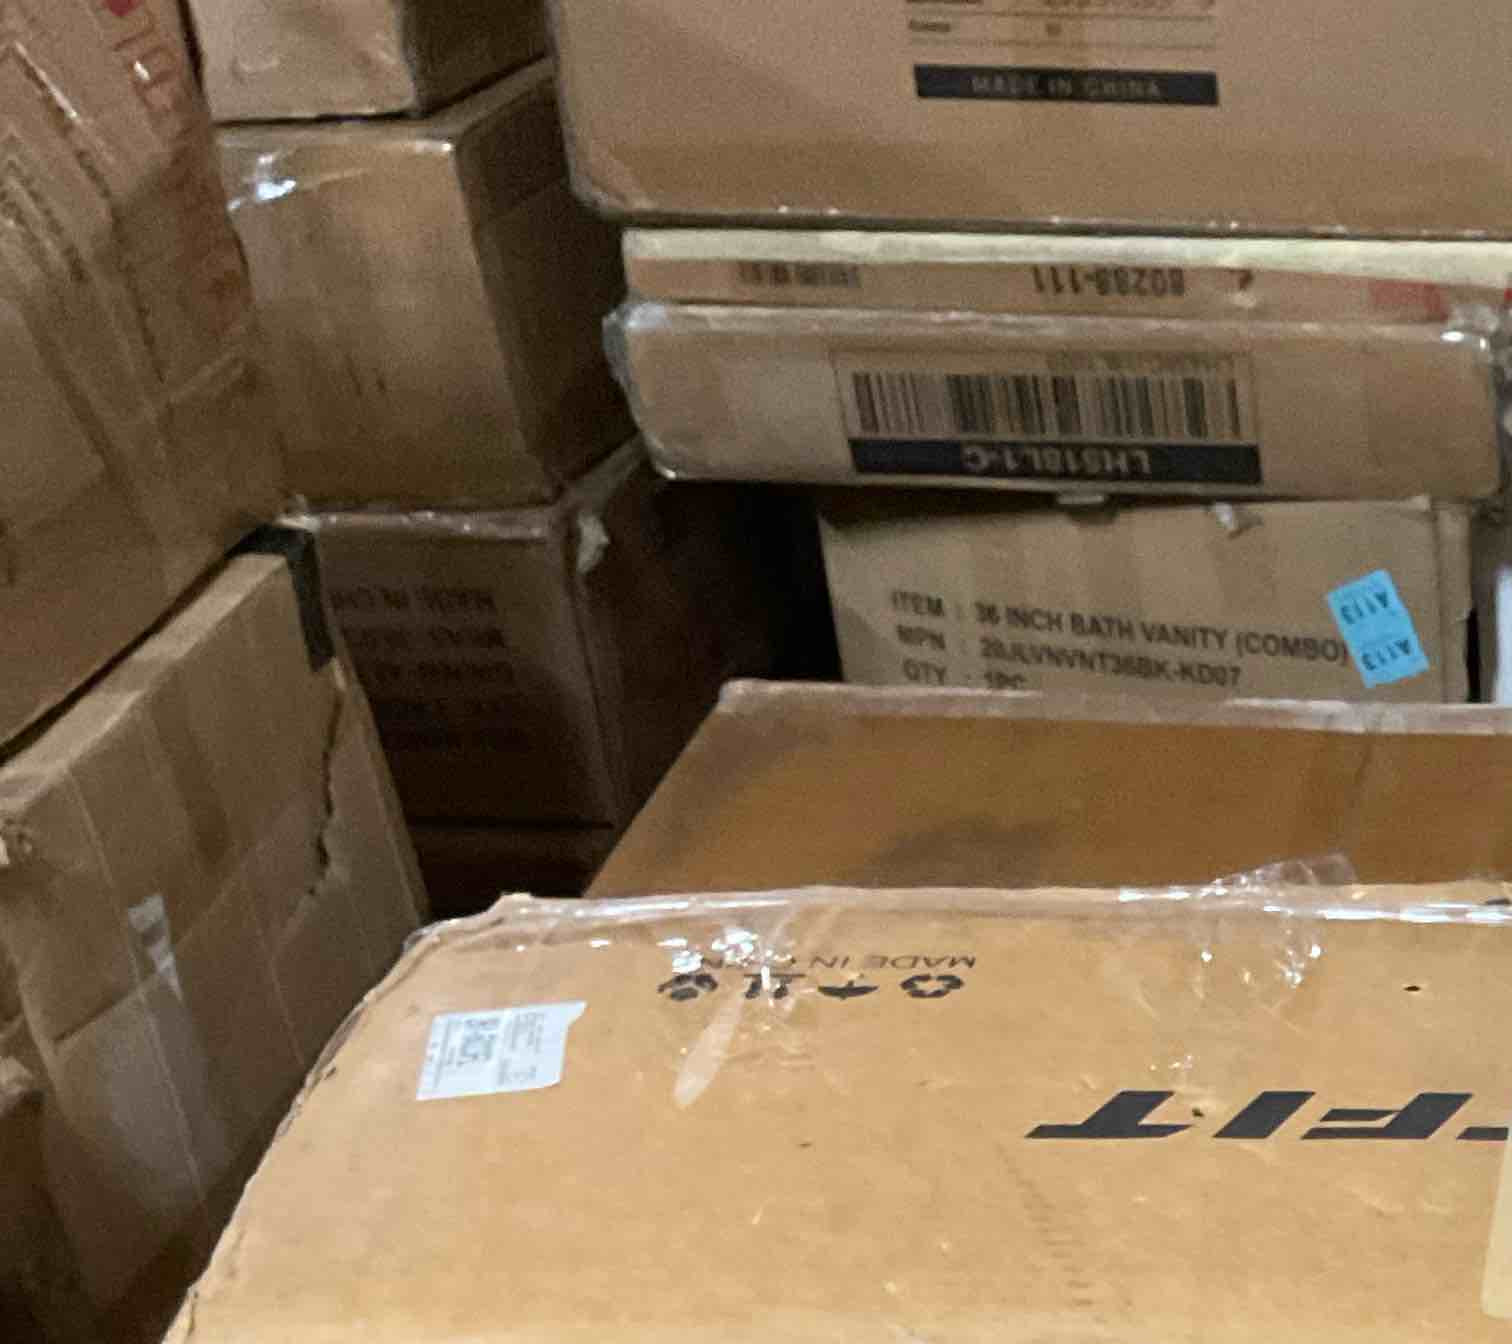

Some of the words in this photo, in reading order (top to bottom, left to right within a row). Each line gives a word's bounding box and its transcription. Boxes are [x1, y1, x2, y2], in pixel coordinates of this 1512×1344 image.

[1049, 75, 1074, 95] IN
[1086, 77, 1162, 98] CHINA
[893, 589, 944, 618] ITEM
[1005, 606, 1063, 632] INCH
[1070, 612, 1134, 640] BATH
[1140, 620, 1228, 650] VANITY
[903, 658, 947, 687] QTY
[810, 955, 852, 970] IN
[870, 954, 978, 969] MADE
